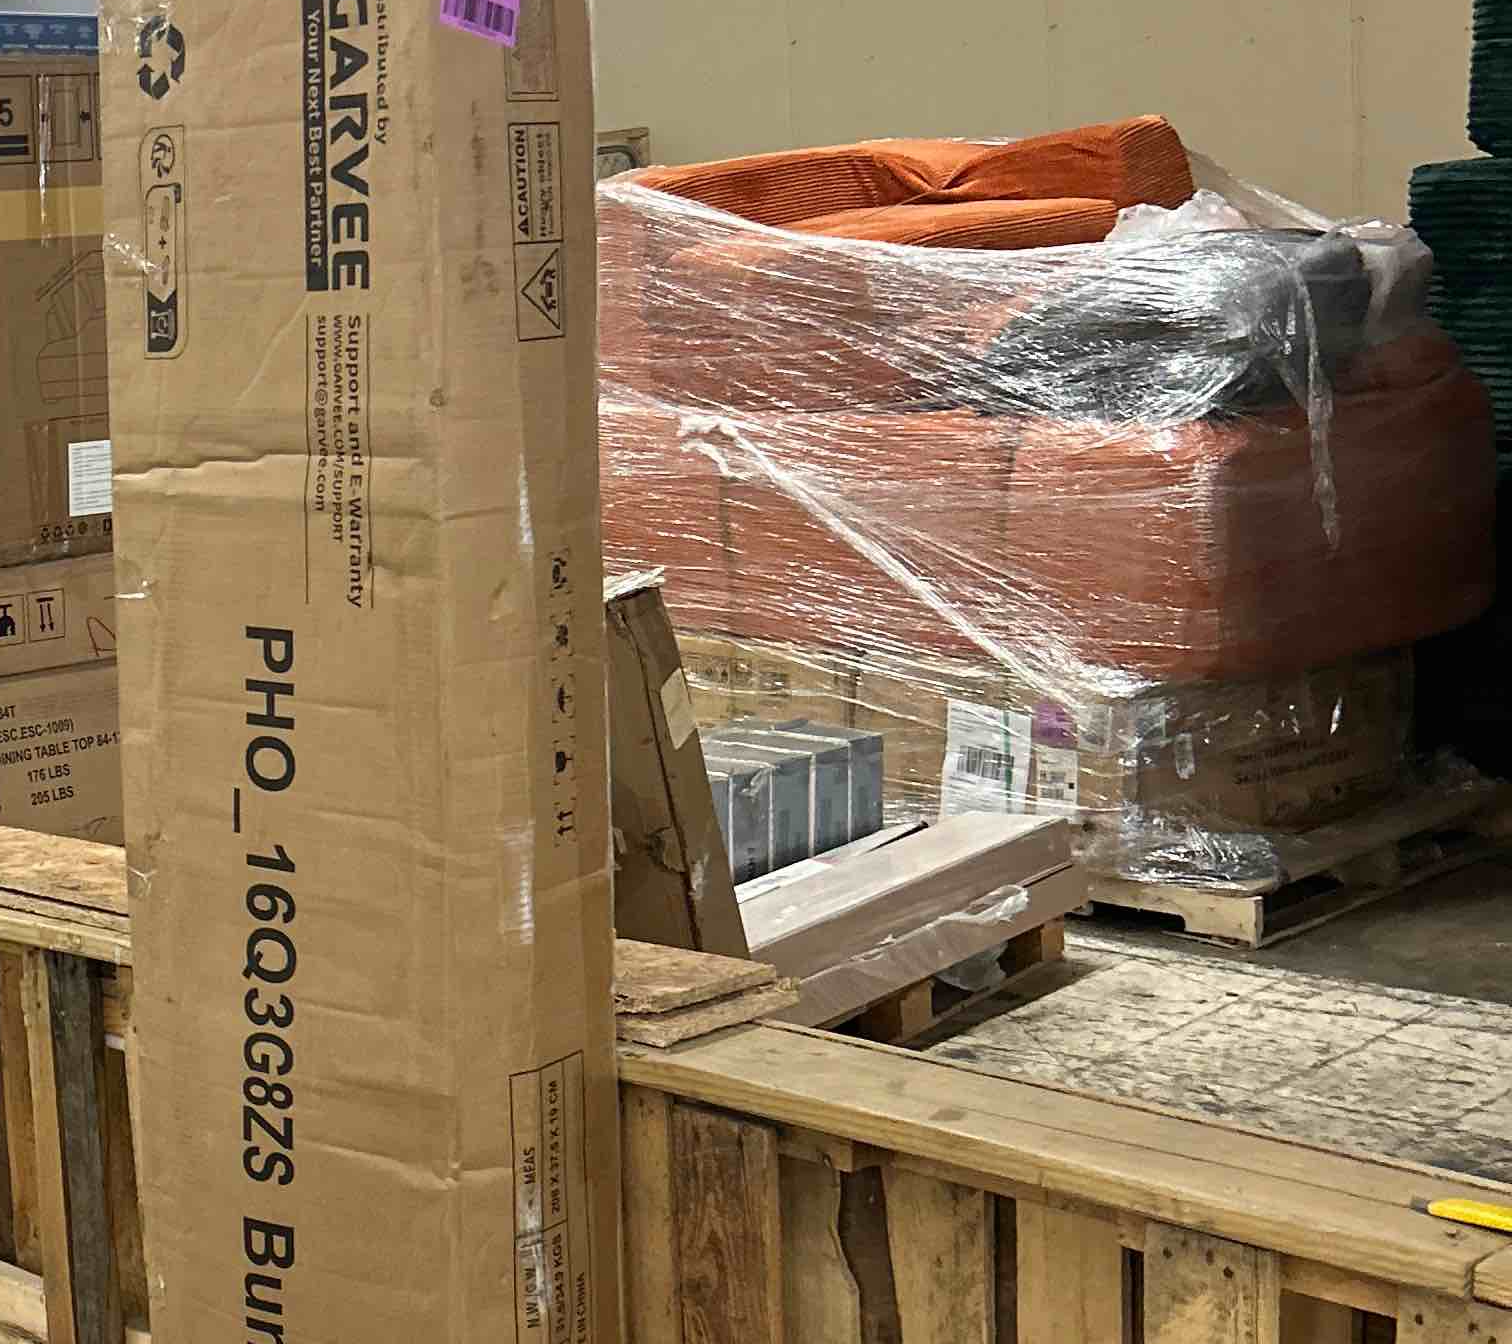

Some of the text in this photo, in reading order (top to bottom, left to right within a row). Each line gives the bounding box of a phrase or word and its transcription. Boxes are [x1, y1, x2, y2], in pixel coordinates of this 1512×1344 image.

[305, 9, 324, 267] Your Next Best Partner
[374, 117, 390, 145] by
[514, 128, 529, 217] CAUTION
[314, 315, 328, 512] support@garvee.com
[347, 315, 363, 608] Support and E-Warranty
[35, 741, 70, 758] TABLE
[72, 736, 95, 752] TOP
[47, 763, 71, 780] LBS
[51, 785, 75, 802] LBS
[232, 625, 299, 1185] PHO_16Q3G8ZS
[547, 1079, 559, 1105] CM
[523, 1146, 536, 1185] MEAS
